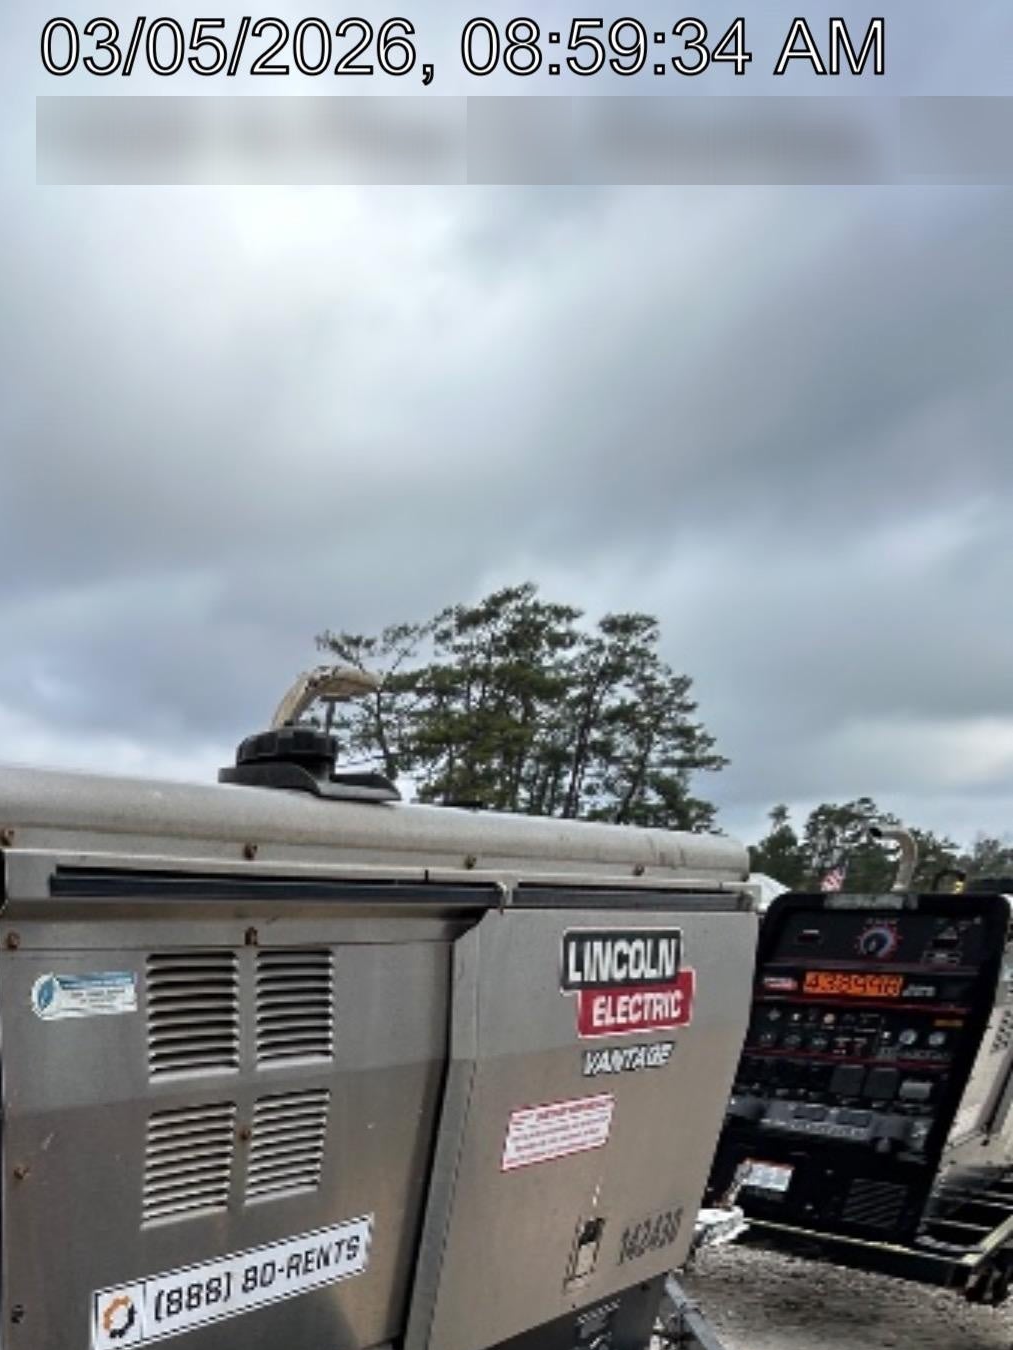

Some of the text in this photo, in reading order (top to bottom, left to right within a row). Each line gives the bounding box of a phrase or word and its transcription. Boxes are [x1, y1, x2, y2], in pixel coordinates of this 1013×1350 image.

[568, 938, 677, 982] LINCOLN
[592, 990, 685, 1028] ELECTRIC
[582, 1041, 675, 1076] VANTAGE
[154, 1271, 231, 1323] (888)
